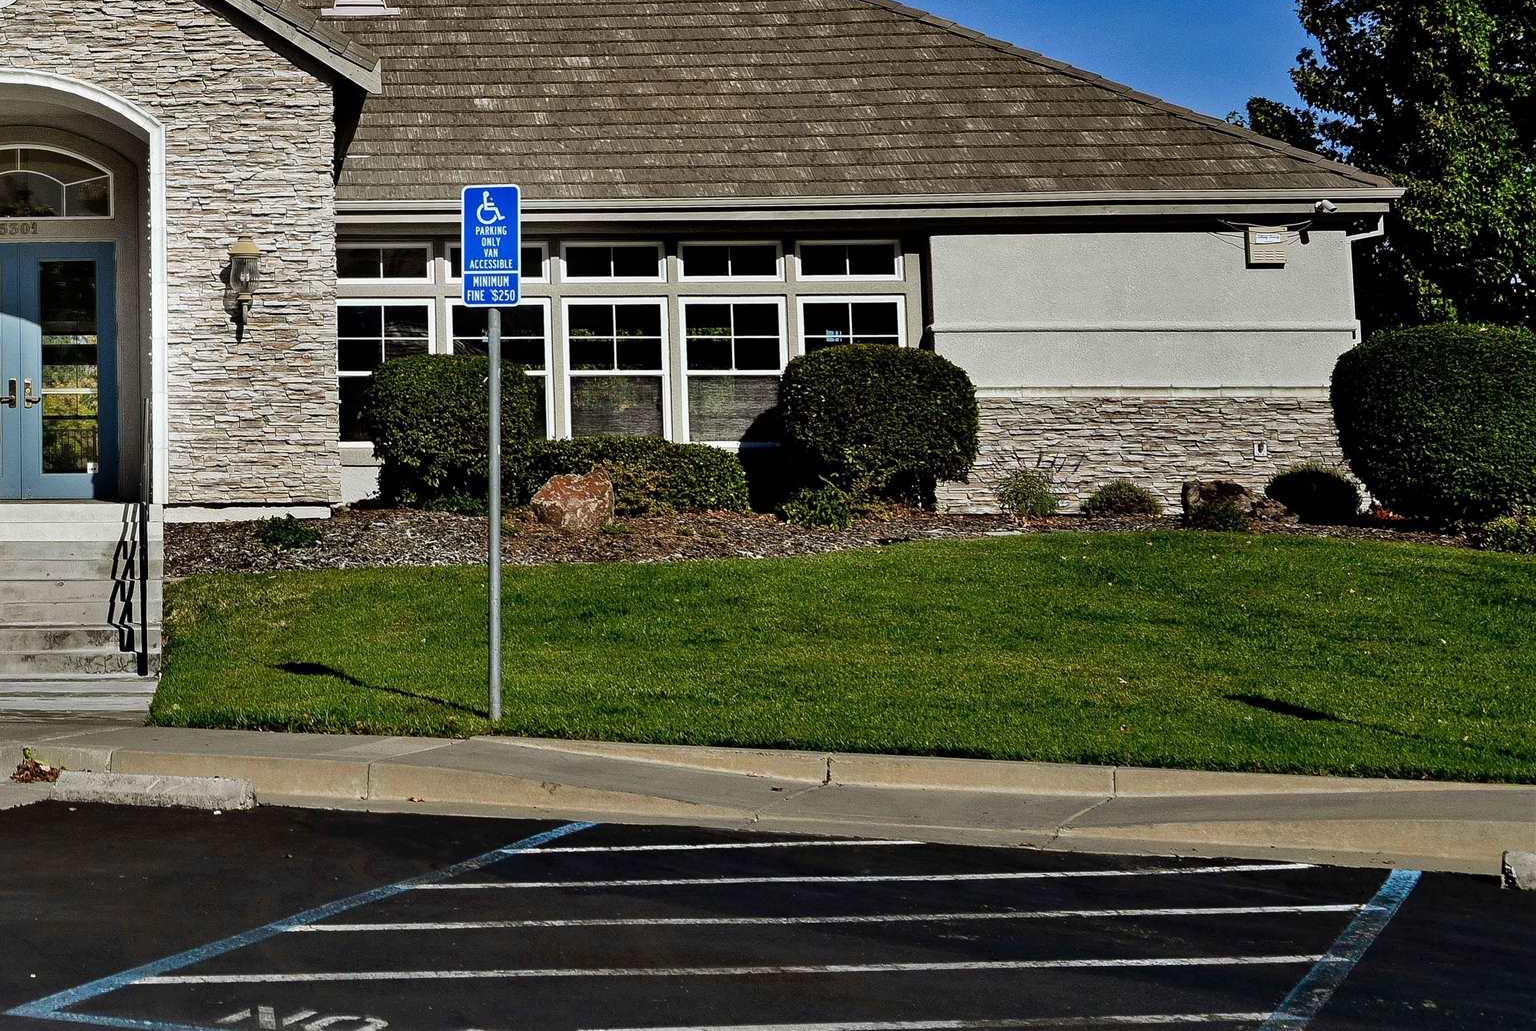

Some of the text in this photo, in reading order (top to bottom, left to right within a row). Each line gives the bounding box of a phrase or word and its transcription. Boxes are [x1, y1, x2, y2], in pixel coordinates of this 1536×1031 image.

[475, 226, 507, 235] PARKING
[481, 237, 500, 247] ONLY
[483, 248, 498, 258] VAN
[469, 259, 512, 269] ACCESSIBLE
[473, 276, 509, 287] MINIMUM
[467, 289, 516, 302] FINE $250
